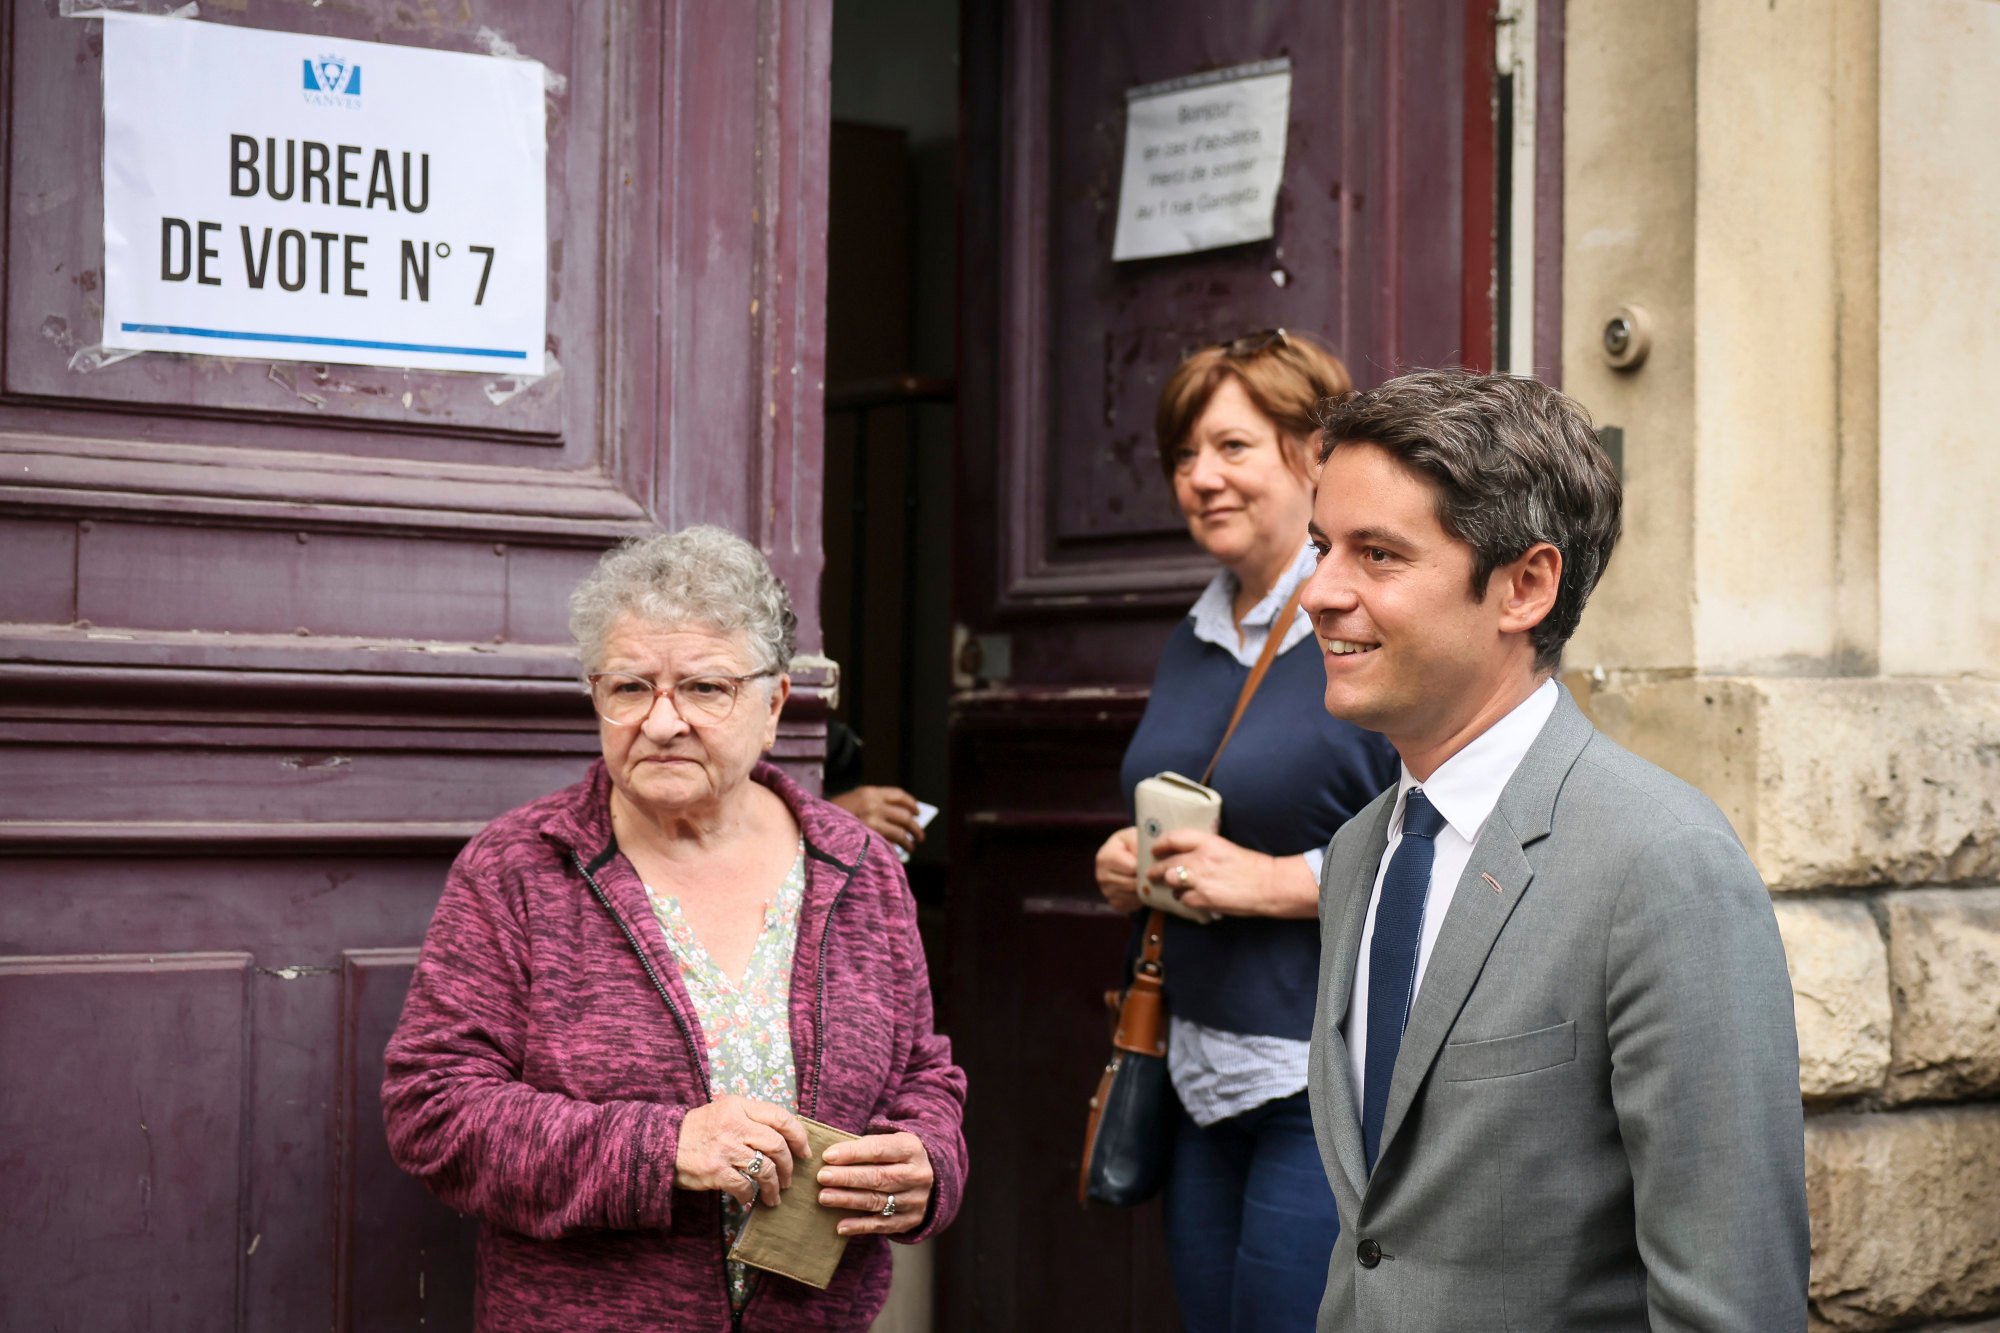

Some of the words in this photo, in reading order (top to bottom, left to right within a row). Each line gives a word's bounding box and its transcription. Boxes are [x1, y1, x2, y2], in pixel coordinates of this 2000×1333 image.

[230, 134, 430, 214] BUREAU
[161, 217, 222, 286] DE
[240, 226, 368, 298] VOTE
[401, 241, 451, 303] N°
[469, 245, 495, 307] 7
